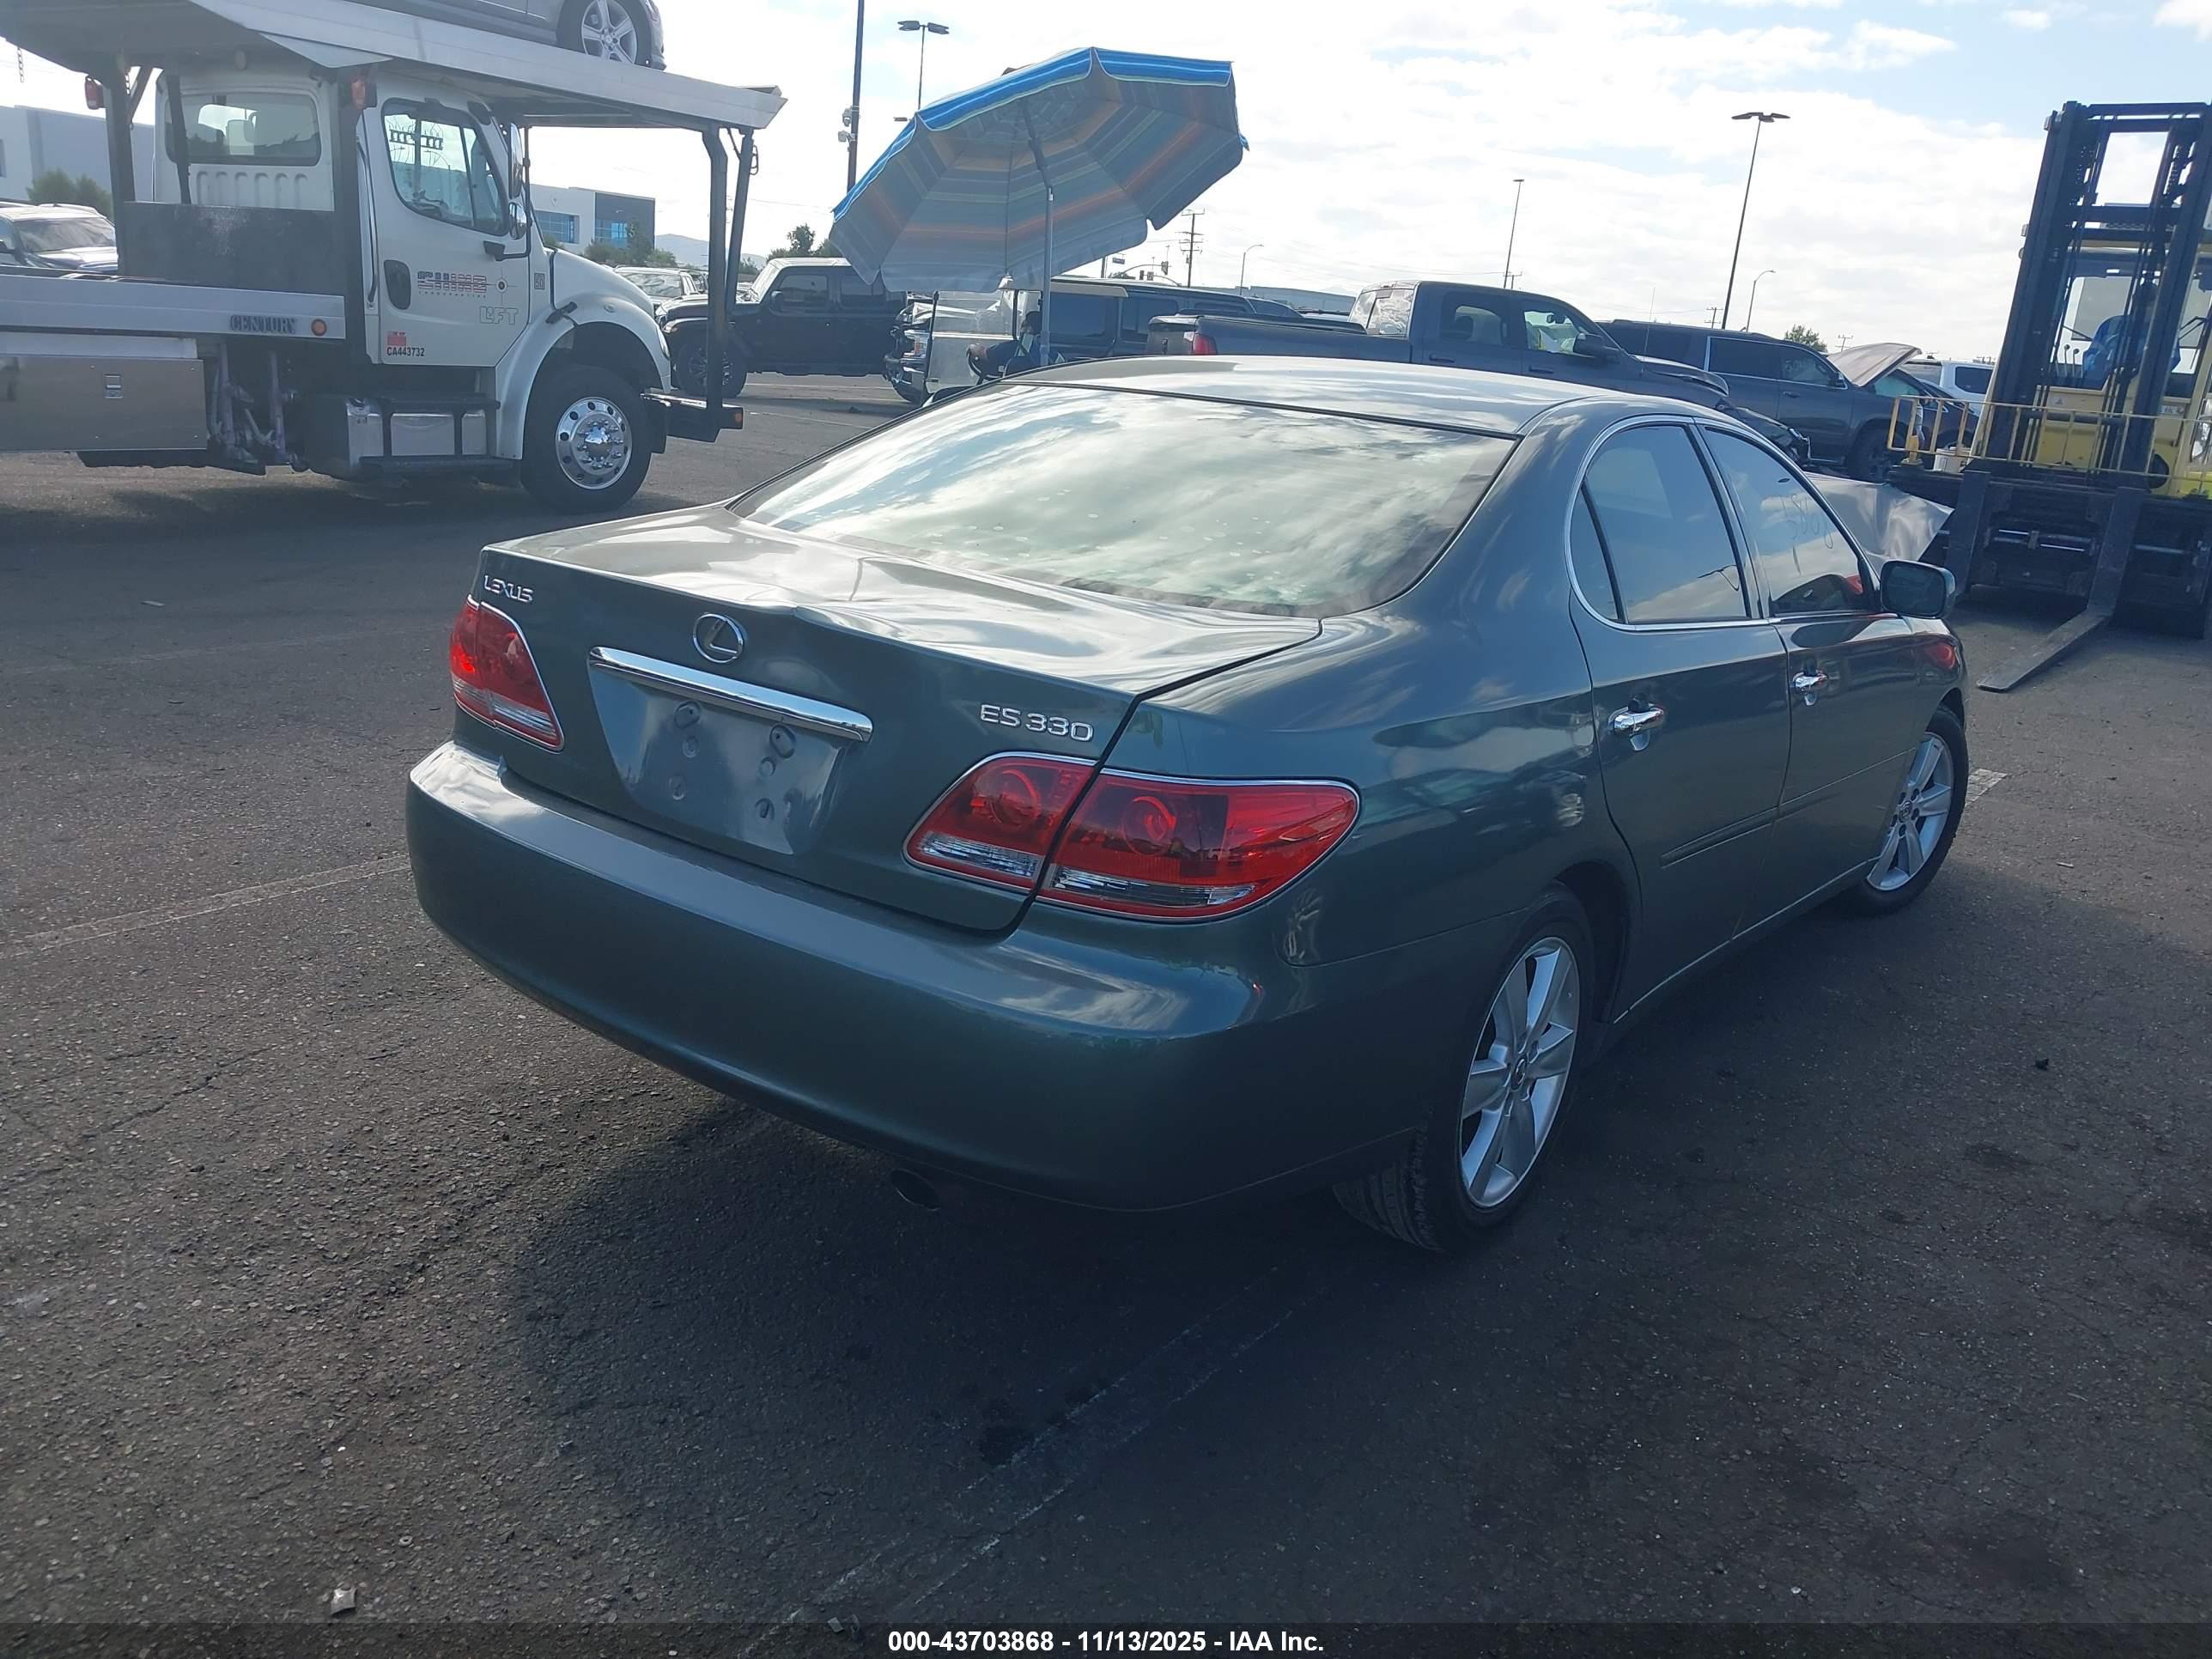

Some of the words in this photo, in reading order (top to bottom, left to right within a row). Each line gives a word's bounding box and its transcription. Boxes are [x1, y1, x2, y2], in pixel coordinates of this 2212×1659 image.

[386, 346, 425, 357] CA443732
[483, 574, 534, 603] LEXUS
[980, 704, 1021, 727] ES
[1025, 713, 1095, 742] 330
